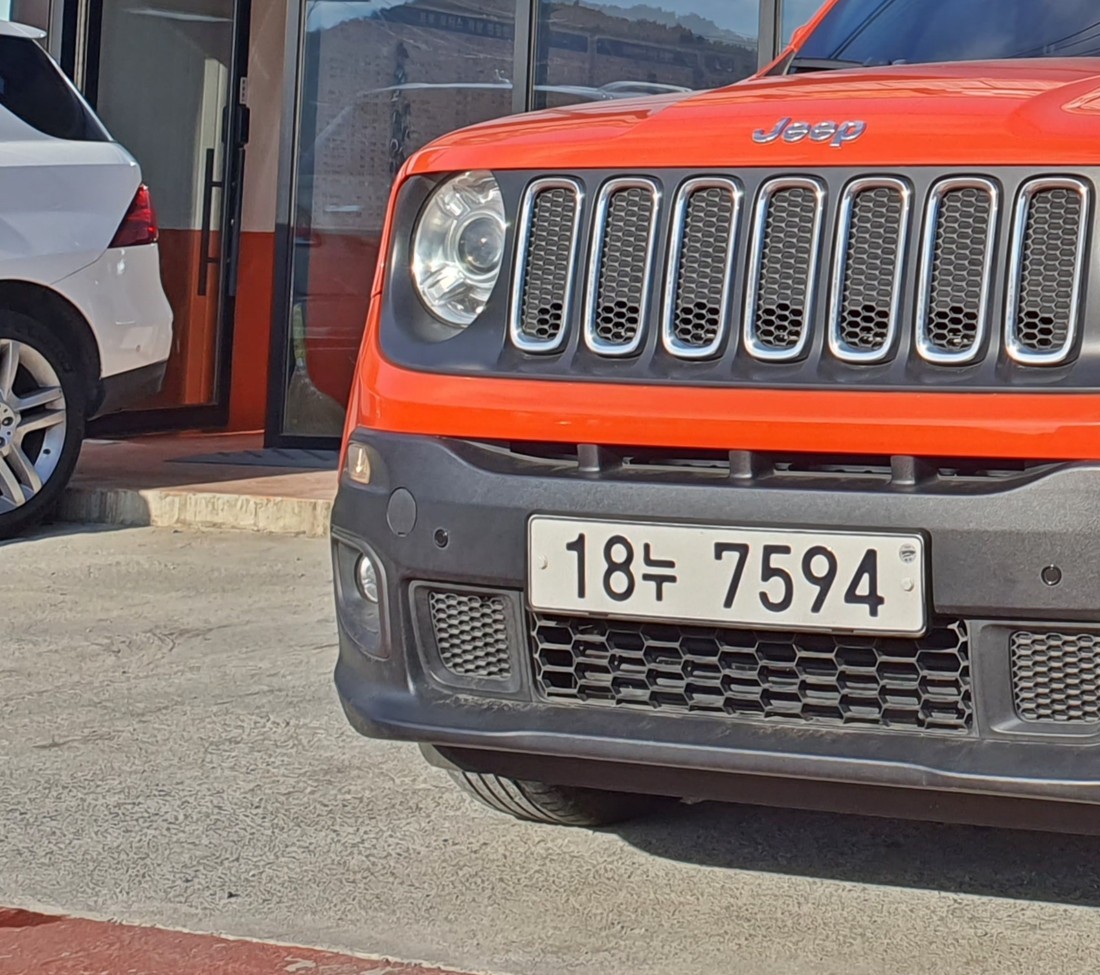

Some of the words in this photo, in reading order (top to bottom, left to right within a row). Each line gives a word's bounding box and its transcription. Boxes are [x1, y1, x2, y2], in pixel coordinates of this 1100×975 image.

[752, 117, 867, 148] Jeep
[566, 533, 677, 602] 18누
[714, 542, 885, 617] 7594
